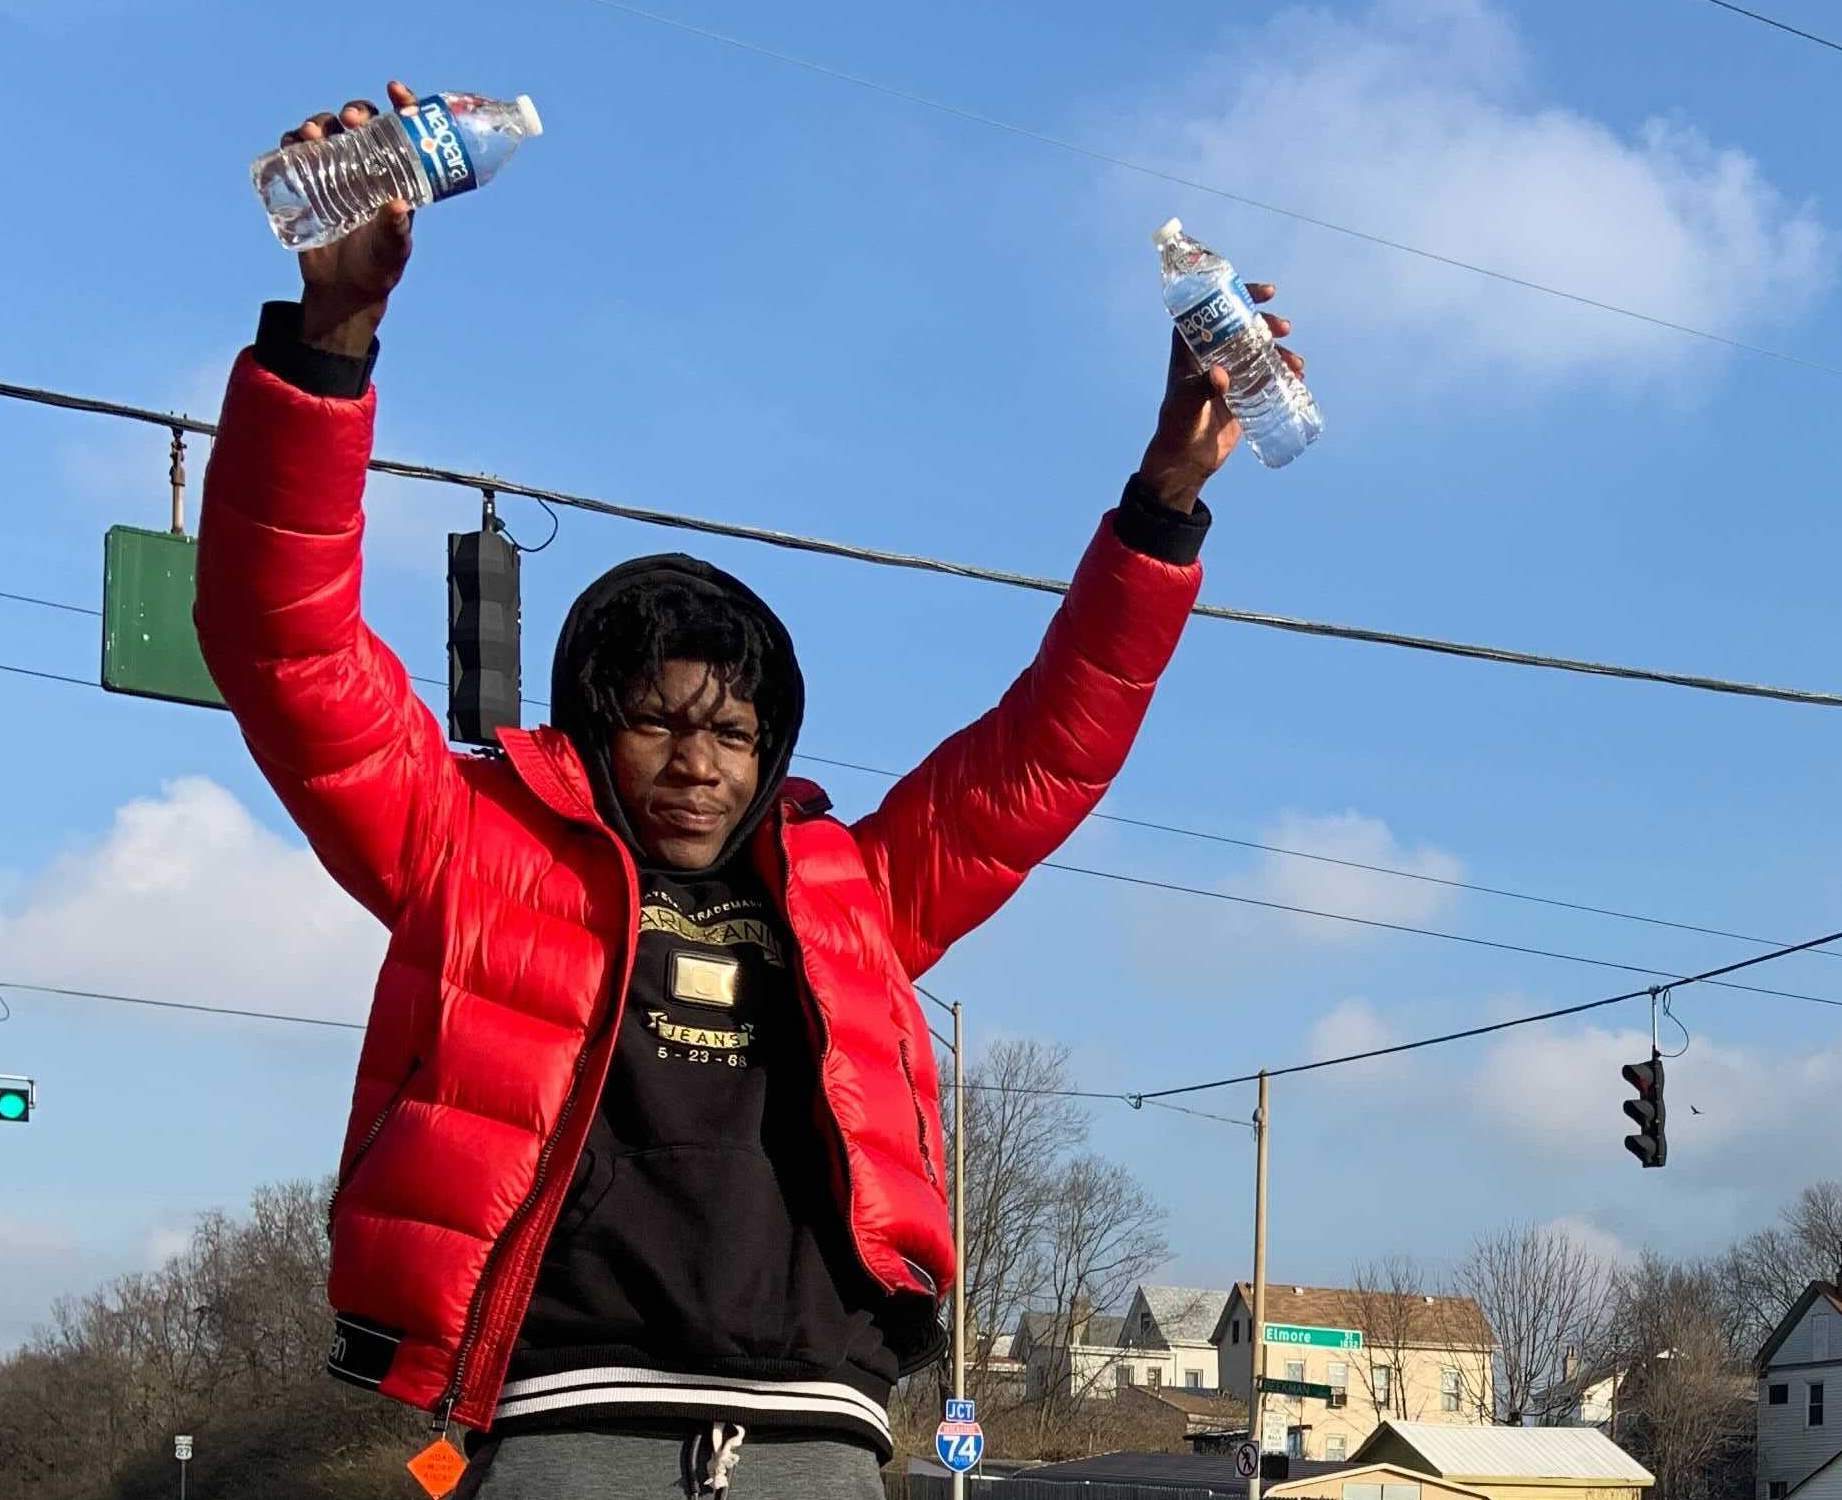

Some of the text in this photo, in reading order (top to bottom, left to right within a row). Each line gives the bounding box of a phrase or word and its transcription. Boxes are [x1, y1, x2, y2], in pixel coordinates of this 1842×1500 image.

[421, 103, 468, 182] niagara
[641, 908, 695, 940] ARL
[667, 1027, 741, 1047] JEANS
[1266, 1327, 1312, 1343] Elmore
[948, 1403, 972, 1418] JCT
[177, 1448, 190, 1457] 27
[942, 1435, 977, 1463] 74
